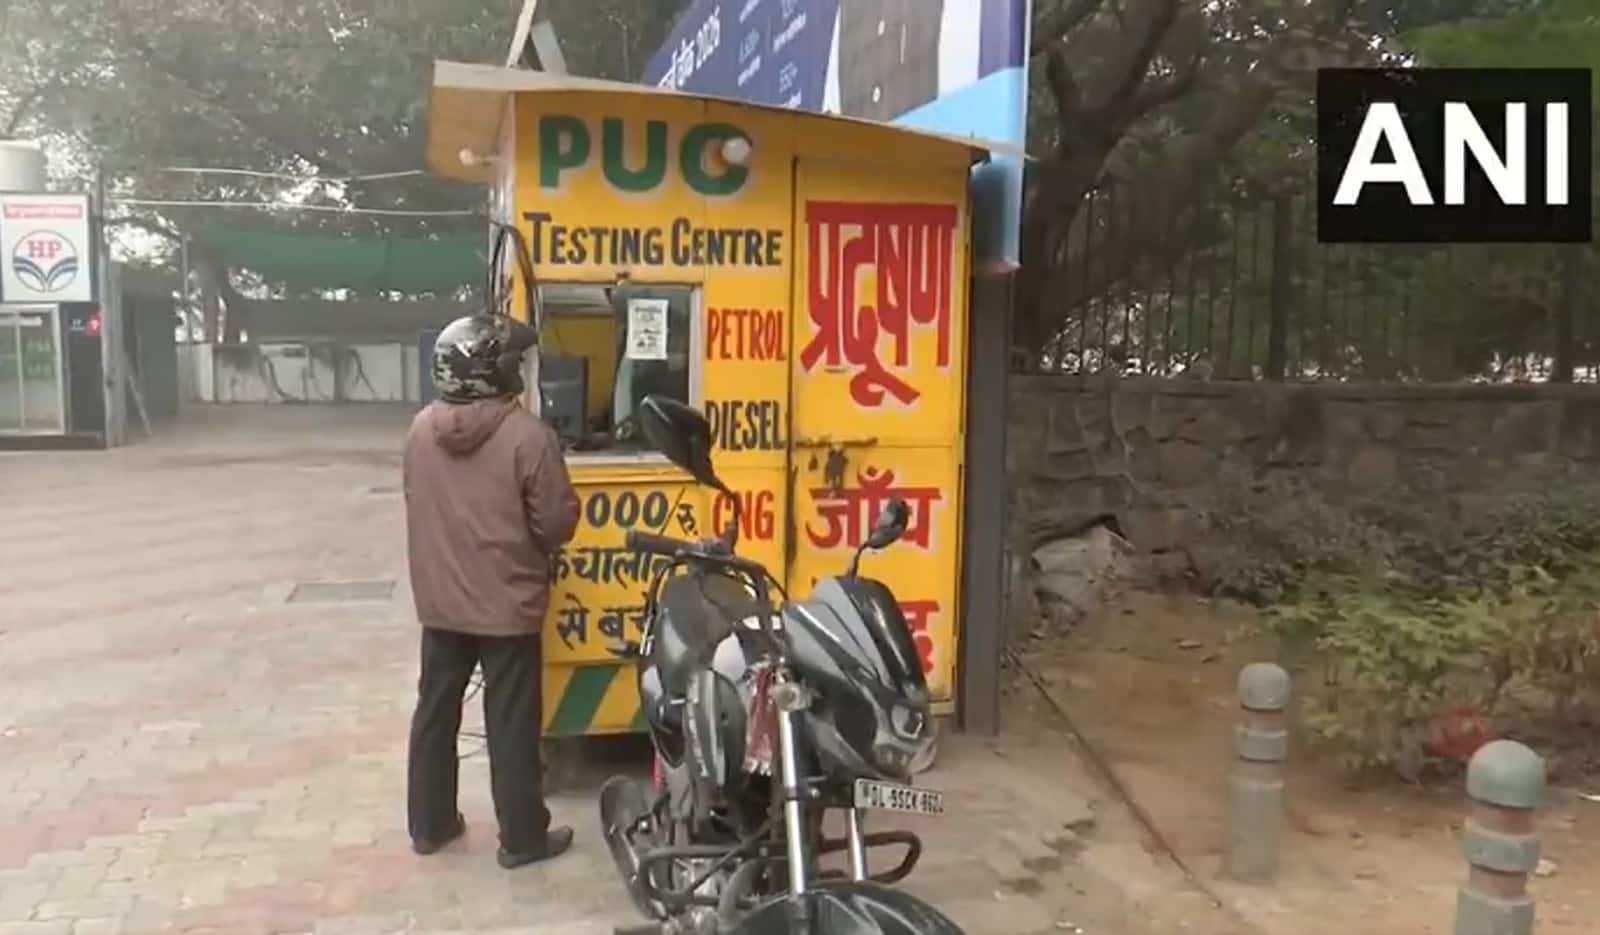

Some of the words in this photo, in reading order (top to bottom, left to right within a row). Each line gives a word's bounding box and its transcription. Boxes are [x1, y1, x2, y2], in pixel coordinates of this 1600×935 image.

[539, 114, 752, 195] PUC
[28, 240, 62, 259] HP
[523, 211, 664, 266] TESTING
[671, 217, 783, 267] CENTRE
[800, 201, 957, 407] प्रदूषण
[706, 307, 787, 361] PETROL
[705, 400, 789, 451] DIESEL
[712, 490, 775, 541] CNG
[556, 593, 590, 650] से
